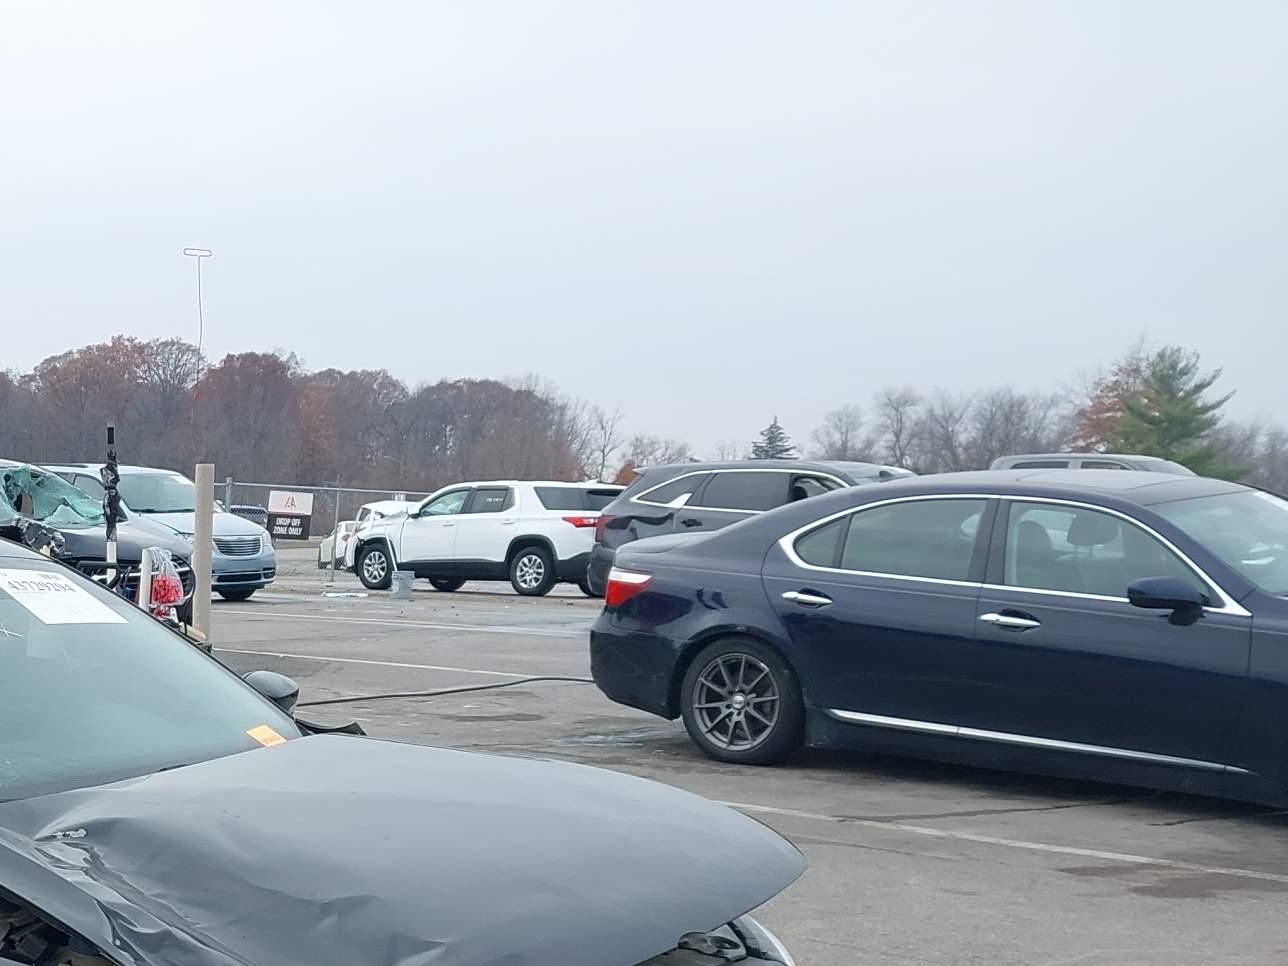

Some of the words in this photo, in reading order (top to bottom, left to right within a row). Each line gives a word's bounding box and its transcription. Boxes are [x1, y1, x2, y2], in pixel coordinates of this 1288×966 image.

[276, 517, 291, 526] DROP
[292, 518, 301, 526] OFF
[273, 526, 288, 535] ZONE
[288, 527, 303, 536] ONLY
